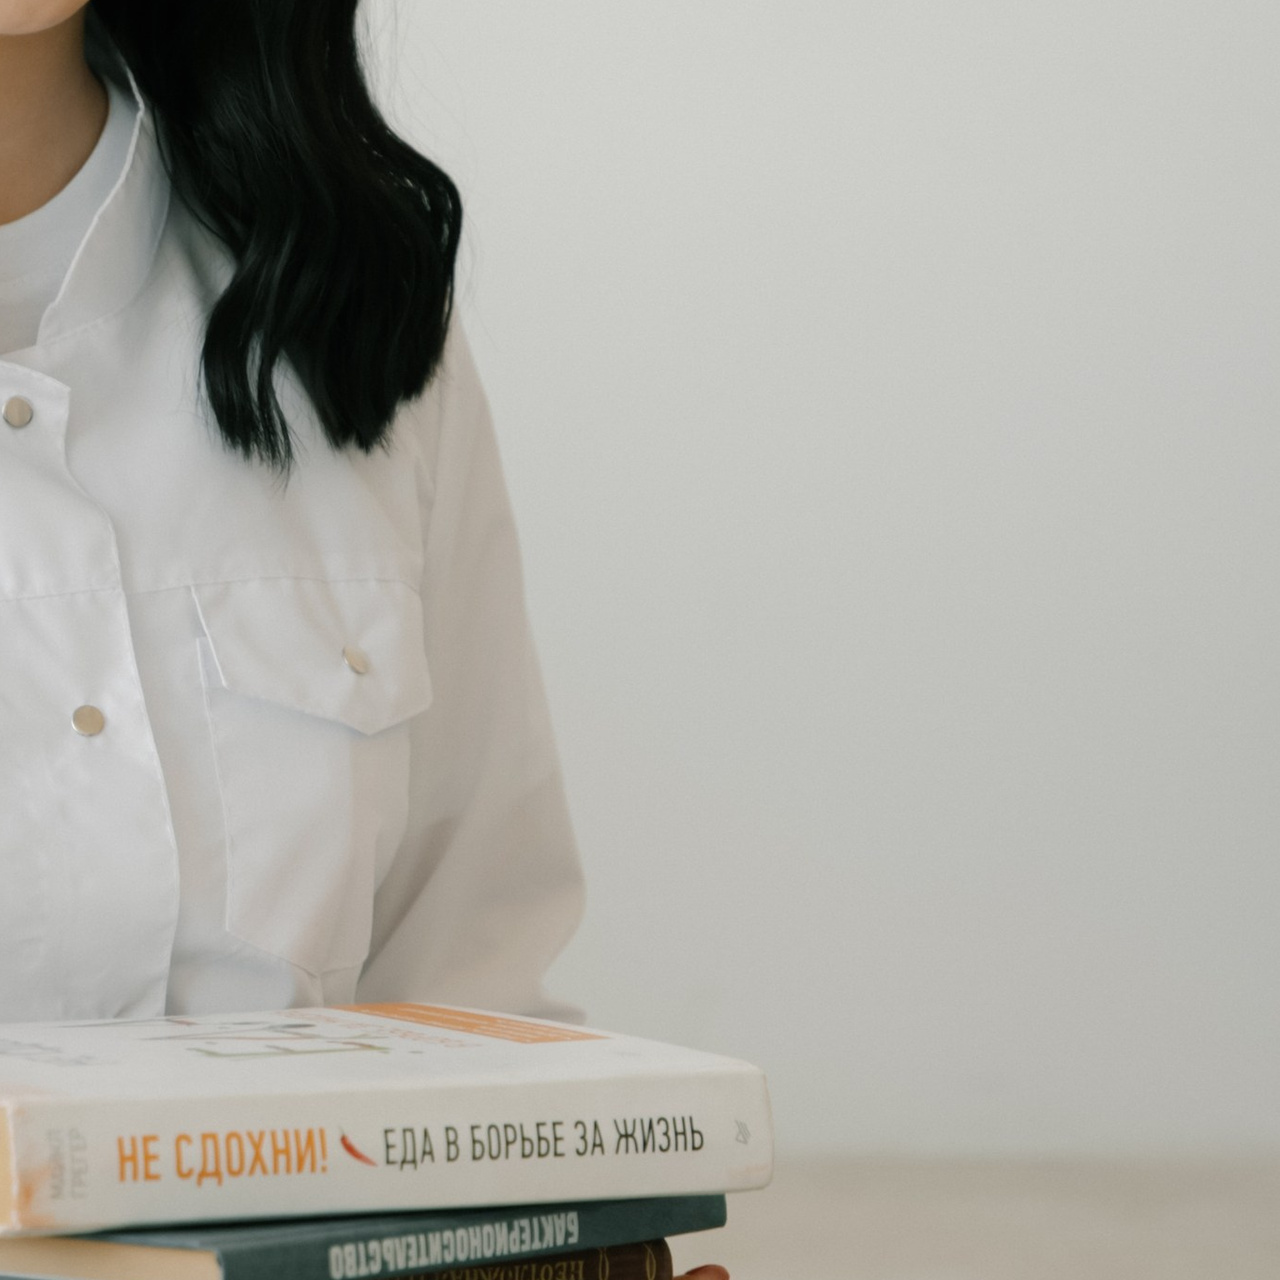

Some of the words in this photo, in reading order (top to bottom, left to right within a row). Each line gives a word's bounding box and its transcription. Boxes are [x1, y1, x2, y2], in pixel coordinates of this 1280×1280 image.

[118, 1135, 161, 1182] НЕ
[175, 1128, 329, 1186] СДОХНИ!
[385, 1127, 436, 1171] ЕДА
[445, 1125, 461, 1163] В
[471, 1120, 565, 1161] БОРЬБЕ
[575, 1119, 606, 1157] ЗА
[613, 1115, 705, 1155] ЖИЗНЬ
[328, 1210, 580, 1280] БАКТЕРИОНОСИТЕЛЬСТВО
